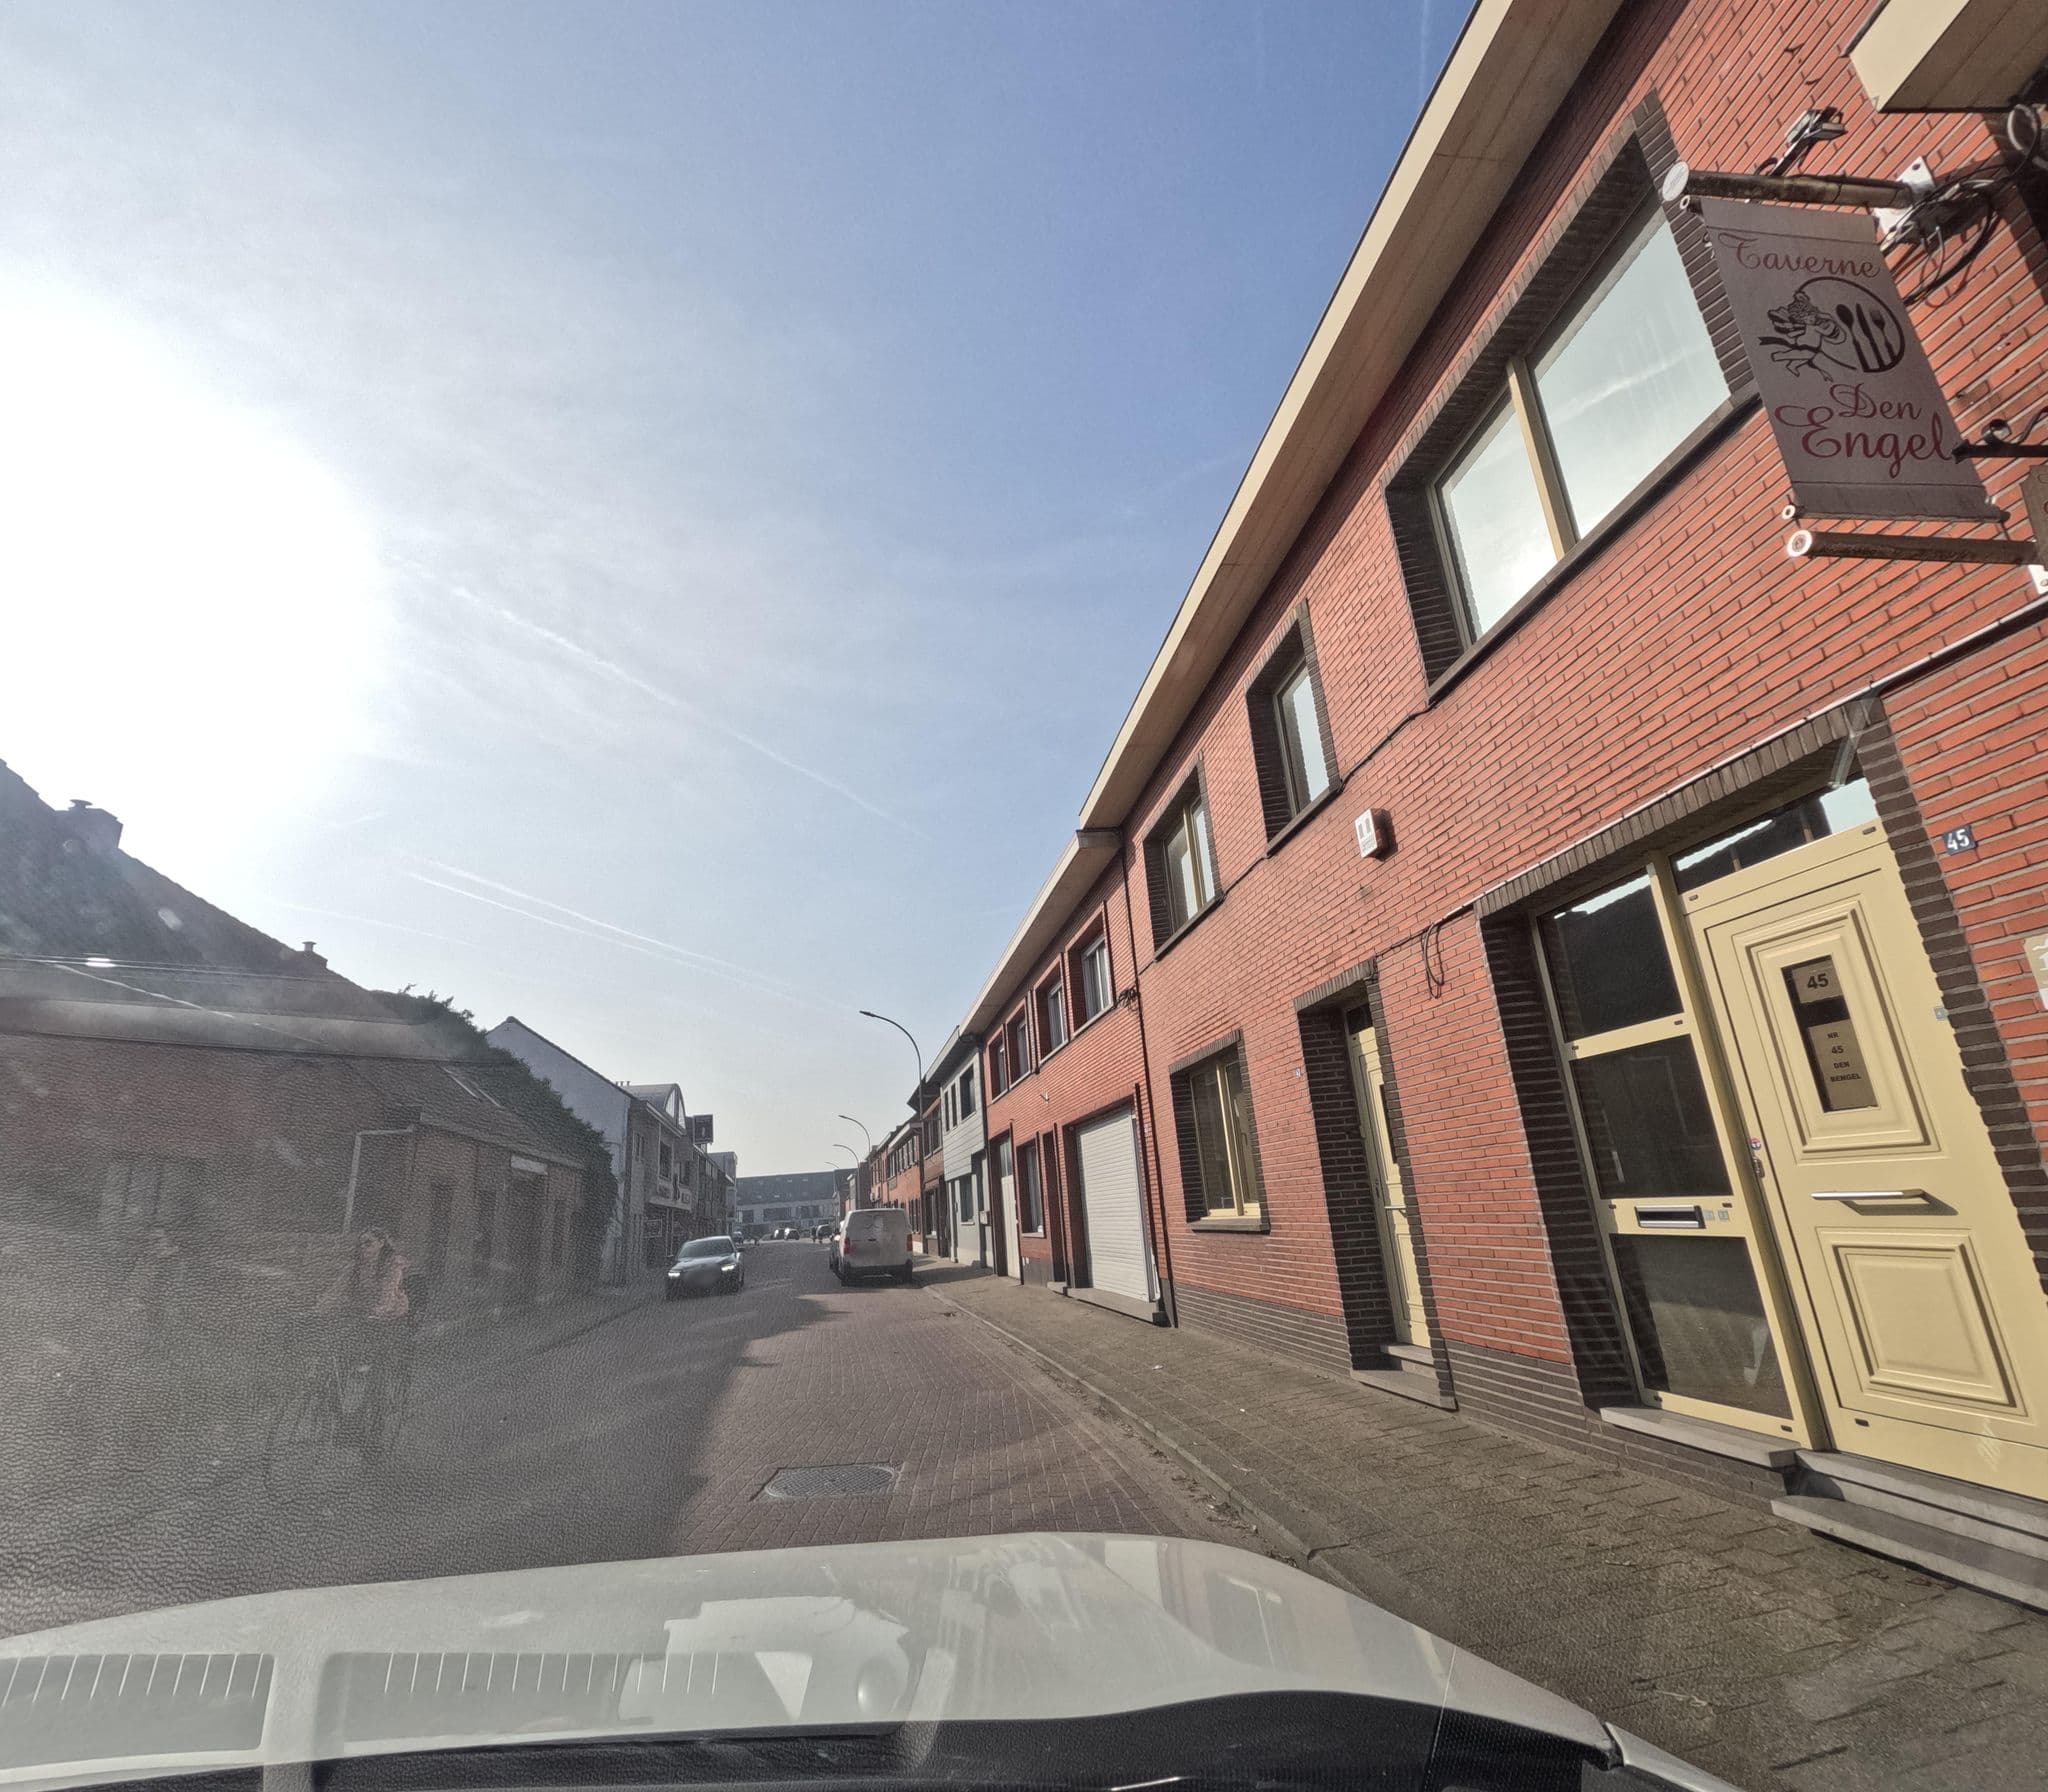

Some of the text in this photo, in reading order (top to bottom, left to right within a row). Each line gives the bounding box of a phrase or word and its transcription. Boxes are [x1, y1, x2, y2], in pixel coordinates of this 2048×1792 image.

[1717, 232, 1880, 279] Taverne
[1829, 382, 1922, 420] Den
[1774, 405, 1953, 478] Engel
[1947, 828, 1970, 850] 45
[1807, 973, 1829, 990] 45
[1831, 1045, 1844, 1054] 45
[1833, 1061, 1850, 1069] DEN
